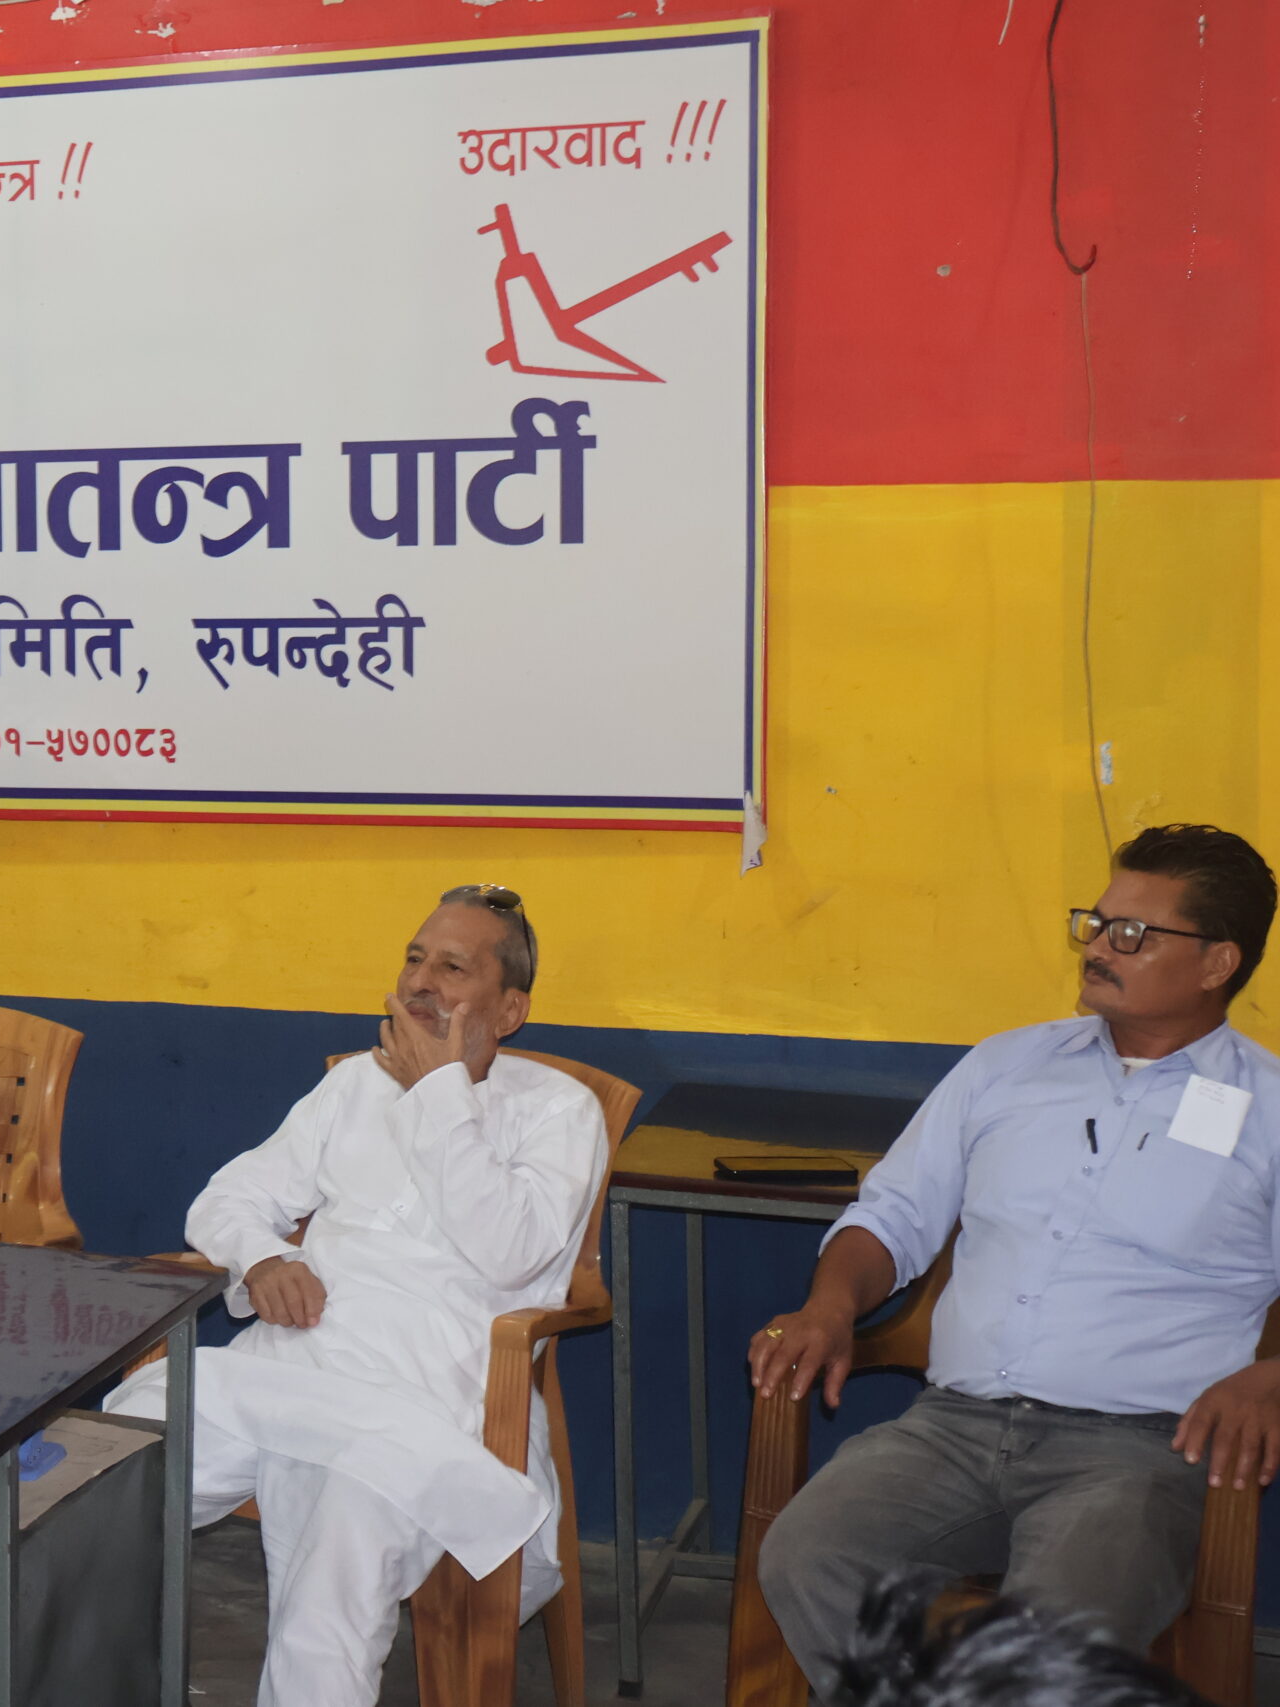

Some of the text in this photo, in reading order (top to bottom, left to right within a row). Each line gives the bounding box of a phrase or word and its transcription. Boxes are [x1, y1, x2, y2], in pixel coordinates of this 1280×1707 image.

[458, 119, 646, 177] उदारवाद
[342, 397, 597, 547] पार्टी
[193, 593, 426, 691] रुपन्देही
